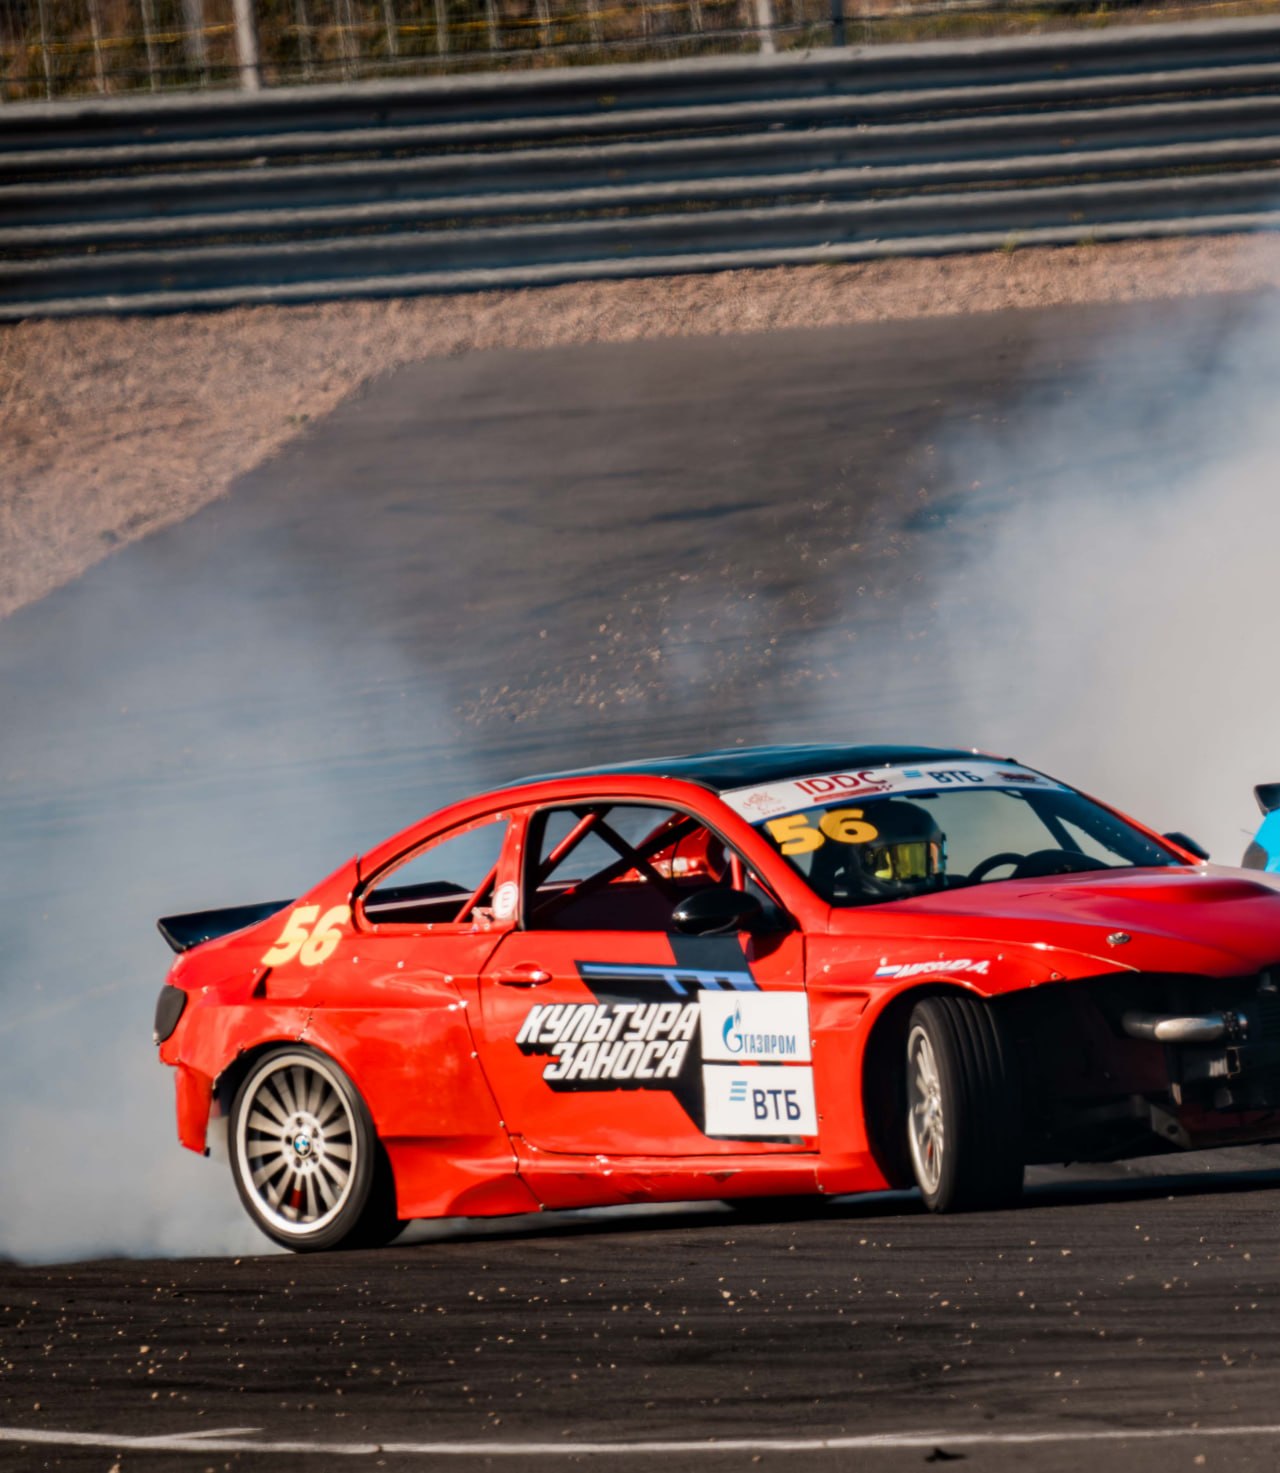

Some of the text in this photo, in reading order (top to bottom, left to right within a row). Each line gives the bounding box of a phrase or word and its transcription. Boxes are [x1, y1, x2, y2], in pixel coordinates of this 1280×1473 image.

[793, 770, 889, 796] IDDC
[928, 769, 985, 784] ВТБ
[767, 808, 879, 856] 56
[260, 904, 352, 967] 56
[514, 1002, 700, 1043] КУЛЬТУРА
[542, 1040, 691, 1080] ЗАНОСА
[743, 1033, 797, 1055] ГАЗПРОМ
[752, 1089, 801, 1121] ВТБ
